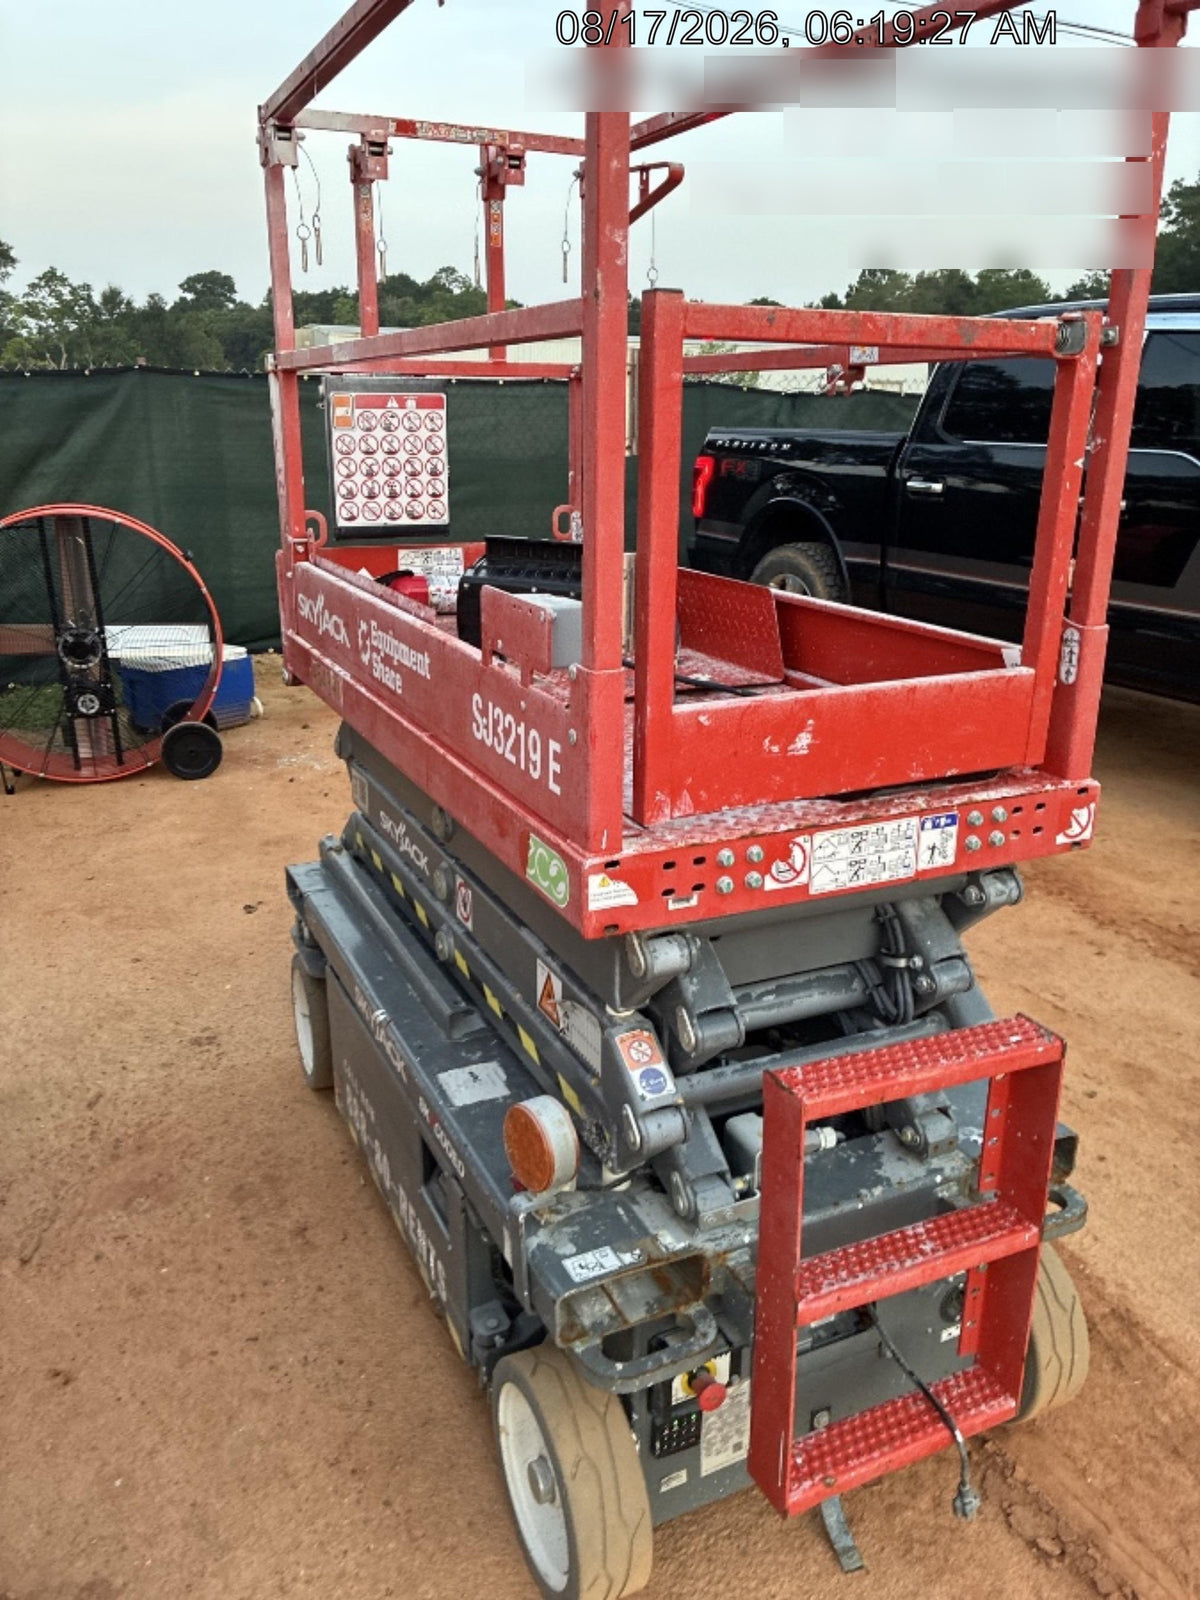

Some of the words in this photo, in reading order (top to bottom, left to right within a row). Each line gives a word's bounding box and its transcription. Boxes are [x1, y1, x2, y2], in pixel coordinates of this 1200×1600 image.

[370, 620, 431, 680] Equipment
[371, 652, 402, 694] Share
[472, 692, 541, 780] SJ3219
[548, 738, 562, 796] E
[380, 810, 430, 876] SKYJACK
